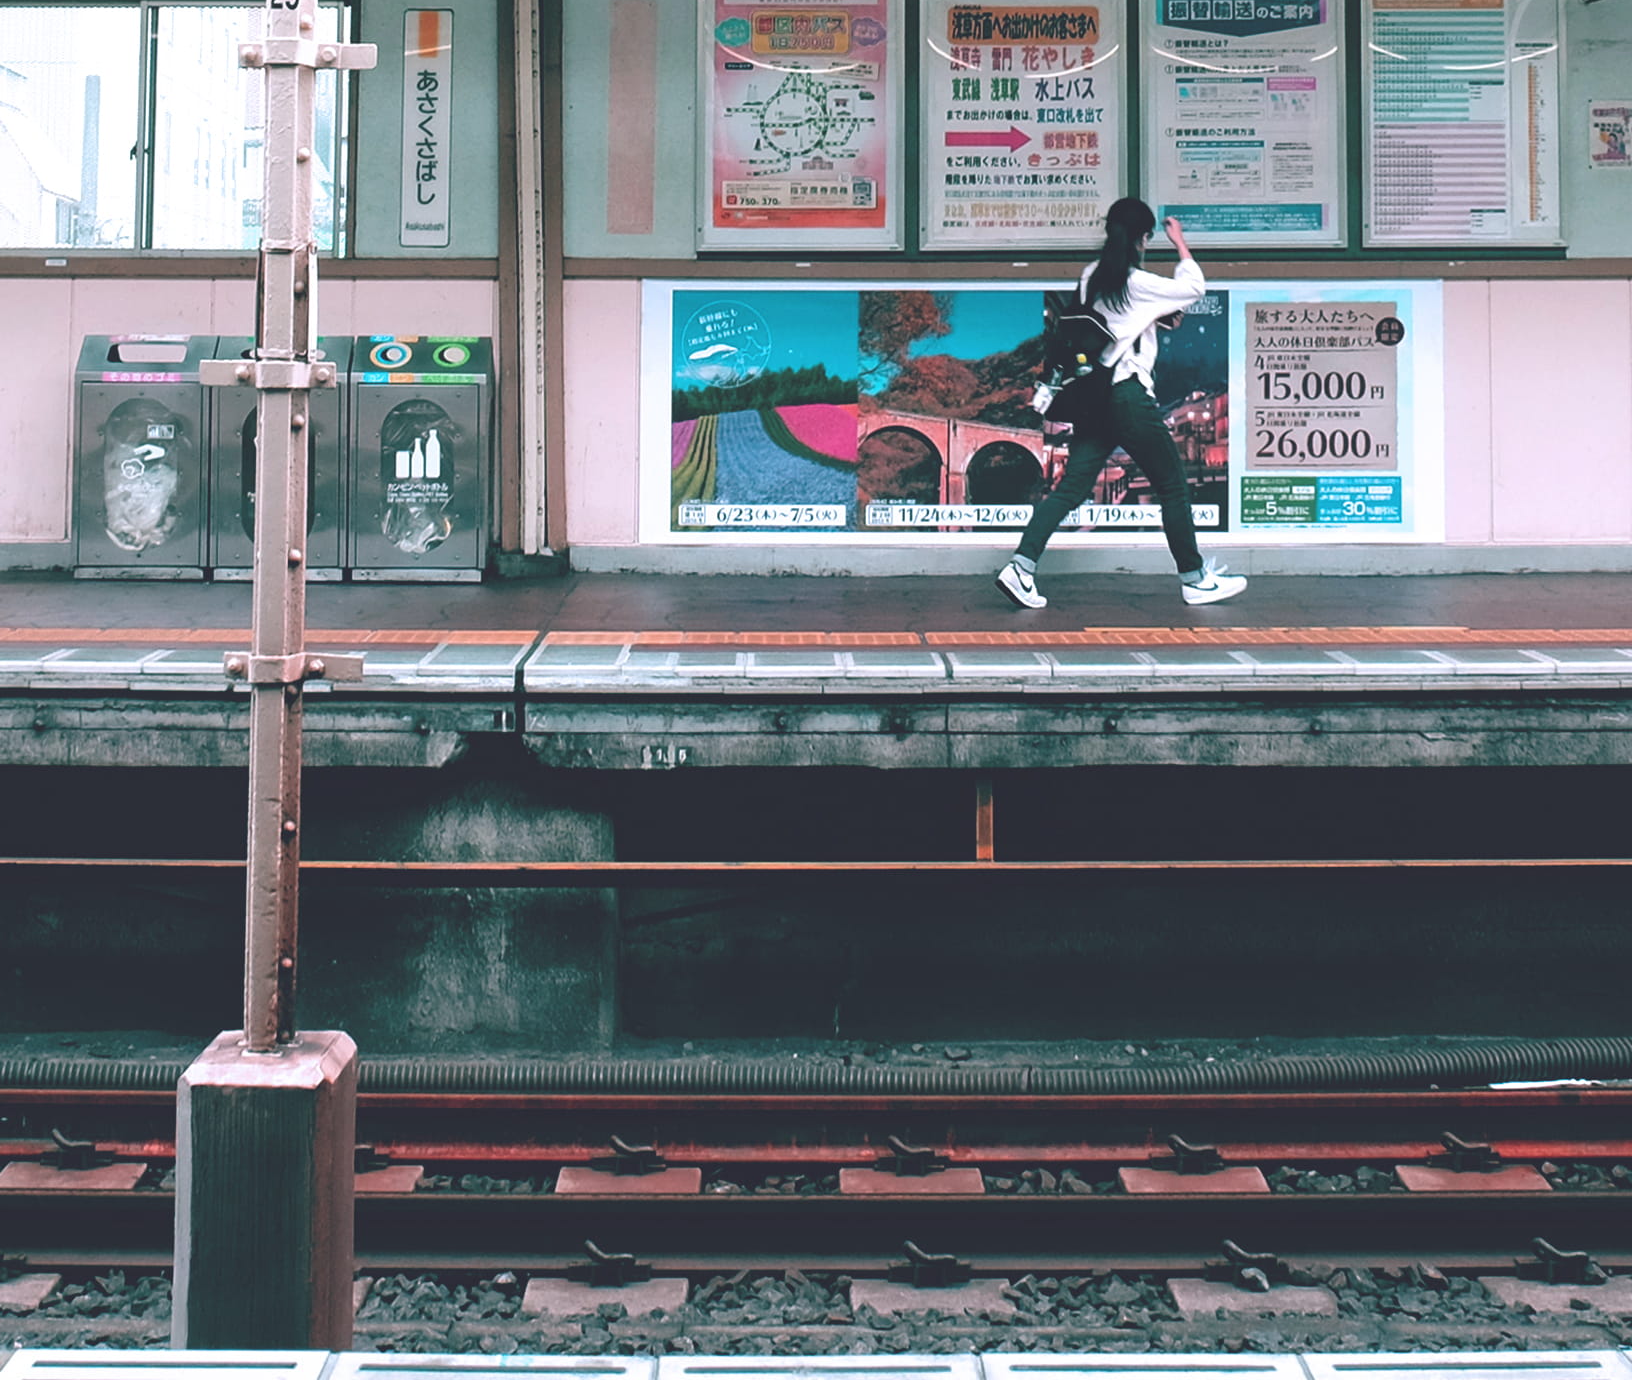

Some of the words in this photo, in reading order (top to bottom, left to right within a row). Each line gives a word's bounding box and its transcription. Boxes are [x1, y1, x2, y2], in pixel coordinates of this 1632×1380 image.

[1169, 0, 1313, 21] 振替輸送のご案内
[952, 11, 1097, 40] 浅草方面へお出かけのお客さまへ
[991, 47, 1013, 72] 雷門
[1022, 46, 1095, 71] 花やしき
[951, 77, 981, 101] 東武線
[1035, 77, 1095, 102] 水上バス
[1036, 107, 1105, 123] 東口改札を出て
[416, 69, 439, 205] あさくさばし
[1043, 131, 1099, 150] 都営地下鉄
[946, 156, 1022, 168] をご利用ください。
[1254, 309, 1375, 324] 旅する大人たちへ
[1254, 336, 1375, 348] 大人の休日倶楽部パス
[1254, 355, 1265, 370] 4
[1257, 371, 1385, 405] 15,000円
[1254, 410, 1265, 427] 5
[1255, 428, 1390, 462] 26,000円
